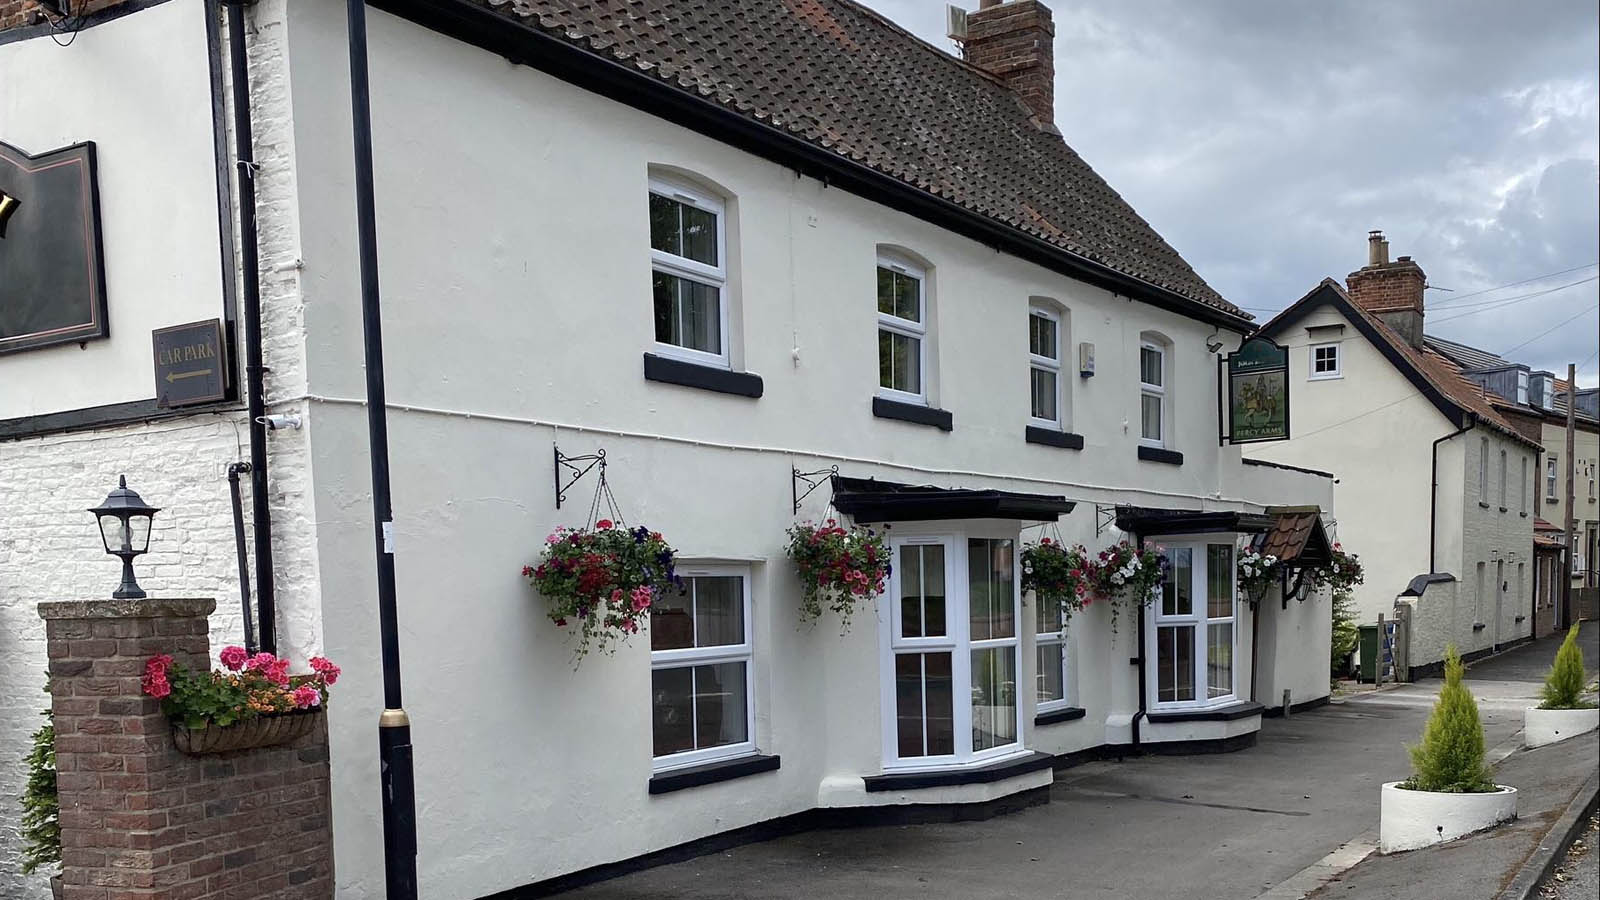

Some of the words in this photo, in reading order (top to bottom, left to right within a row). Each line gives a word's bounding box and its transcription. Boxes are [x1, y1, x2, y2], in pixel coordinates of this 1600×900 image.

[159, 347, 182, 365] CAR
[184, 342, 215, 360] PARK
[1236, 429, 1259, 437] PERCY
[1261, 427, 1282, 435] ARMS
